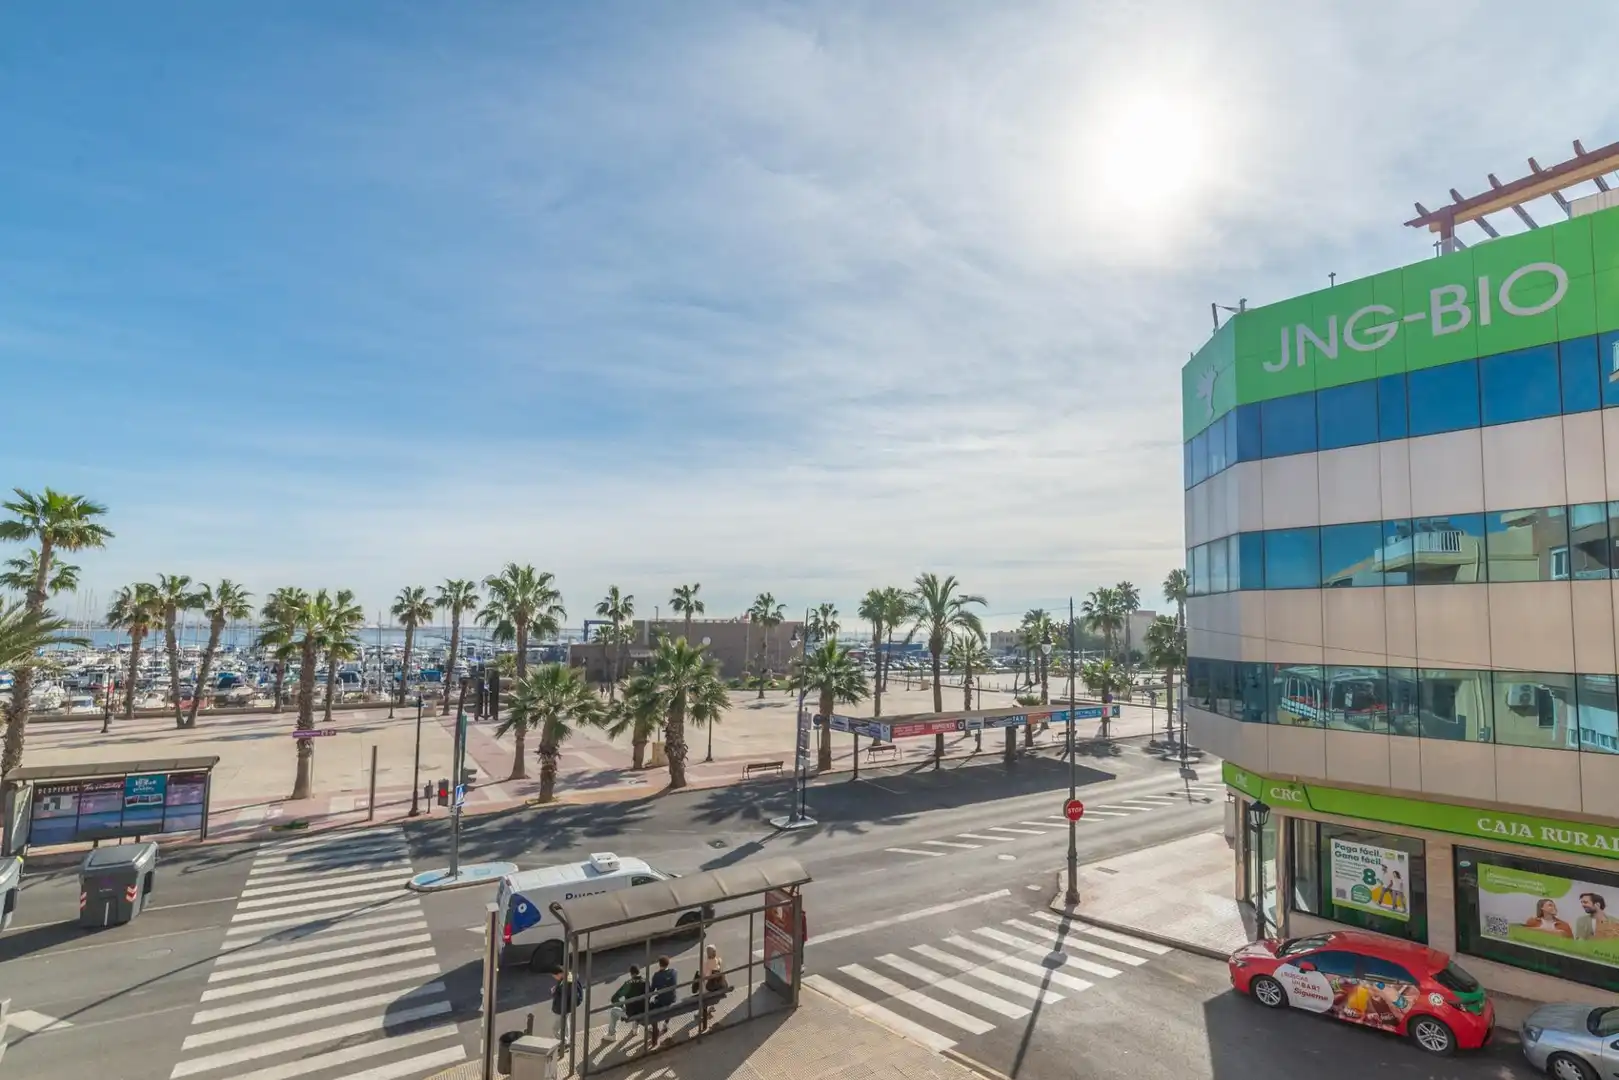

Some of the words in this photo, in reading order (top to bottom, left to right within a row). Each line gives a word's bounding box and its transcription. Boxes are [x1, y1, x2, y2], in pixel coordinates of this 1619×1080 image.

[1263, 262, 1568, 372] JNG-BIO
[1270, 787, 1302, 803] CRC
[1477, 818, 1534, 838] CAJA
[1335, 842, 1358, 853] Paga
[1335, 850, 1359, 861] Gana
